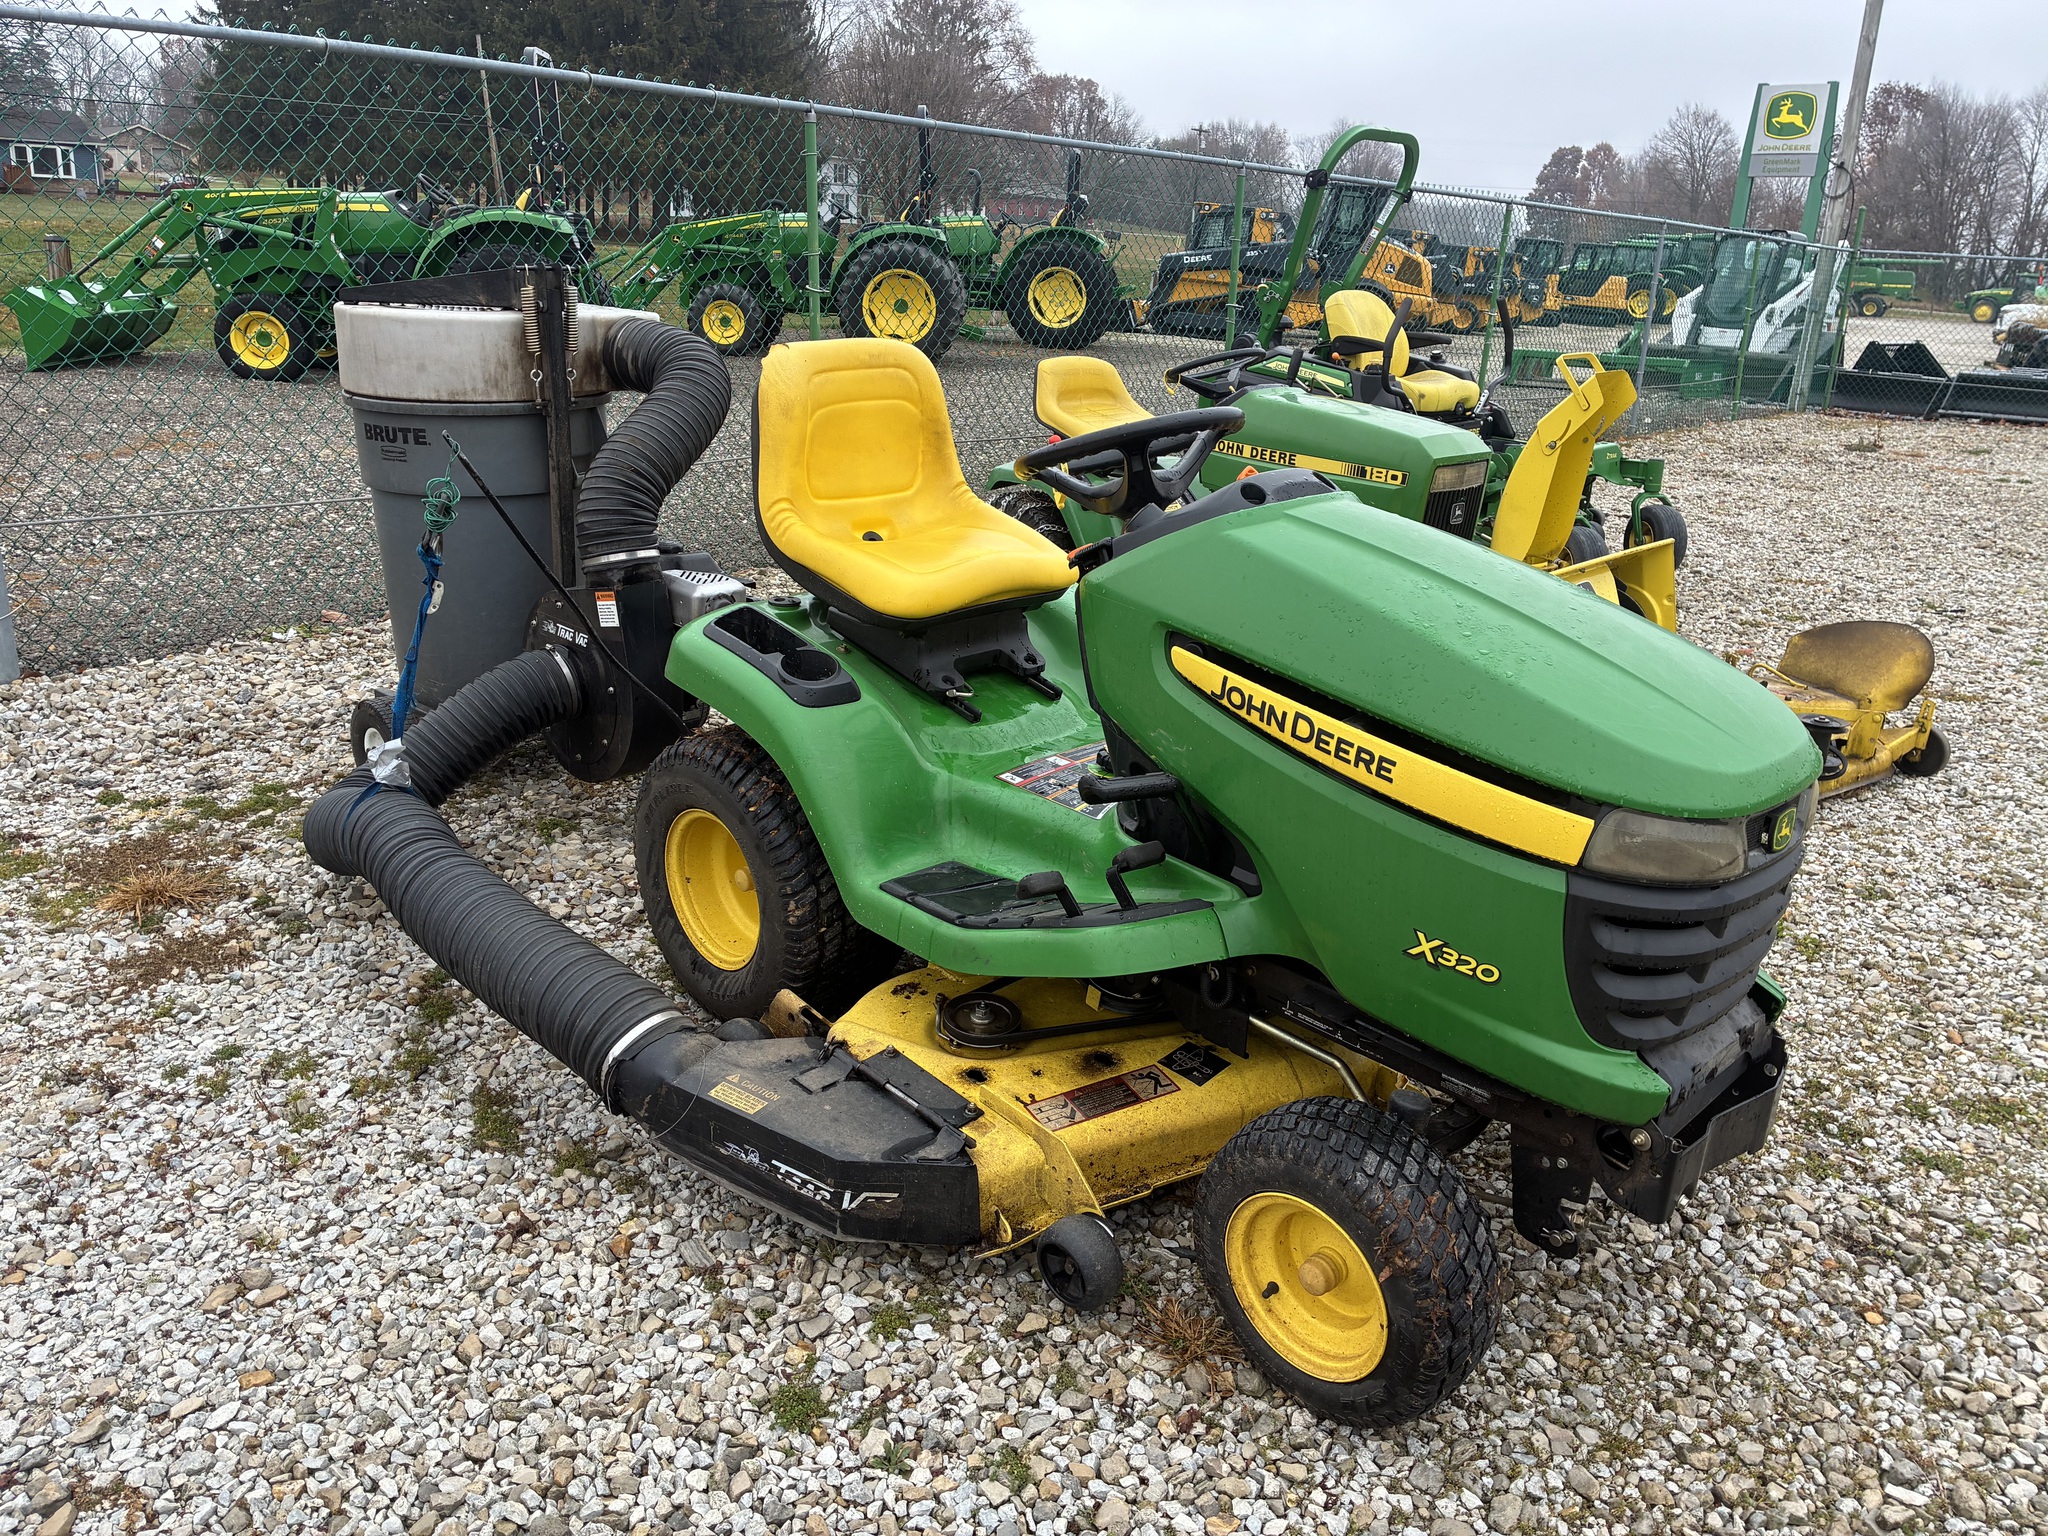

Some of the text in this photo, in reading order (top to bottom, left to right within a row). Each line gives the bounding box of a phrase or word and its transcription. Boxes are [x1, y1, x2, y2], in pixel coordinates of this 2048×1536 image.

[1758, 143, 1812, 152] JOHN DEERE
[1183, 254, 1213, 264] DEERE
[363, 423, 428, 446] BRUTE
[1214, 439, 1403, 486] OHN DEERE 180
[556, 623, 589, 647] TRAC VAC
[1210, 675, 1397, 784] JOHN DEERE
[1403, 929, 1501, 984] X320
[740, 1080, 781, 1102] CAUTION
